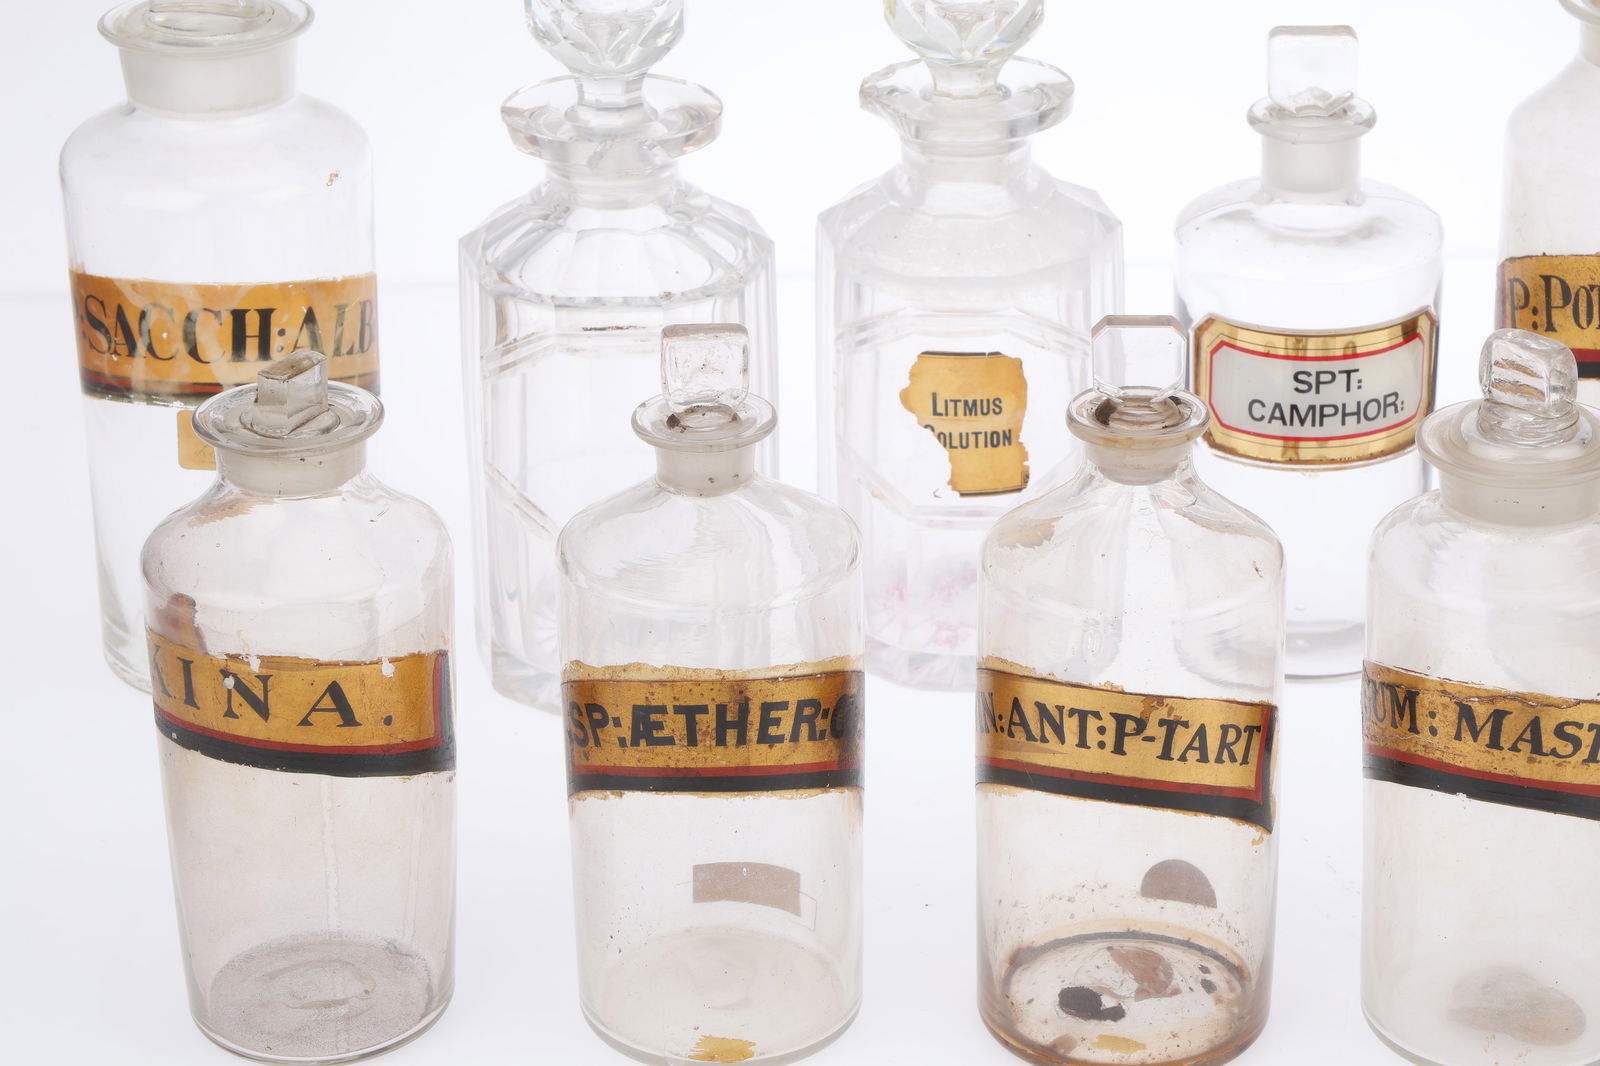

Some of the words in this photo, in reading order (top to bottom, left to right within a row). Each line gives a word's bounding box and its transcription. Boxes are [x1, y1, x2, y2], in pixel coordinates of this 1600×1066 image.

[1293, 368, 1363, 395] SPT:
[931, 391, 1003, 417] LITMUS
[1248, 391, 1405, 428] CAMPHOR:
[924, 424, 1013, 450] OLUTION
